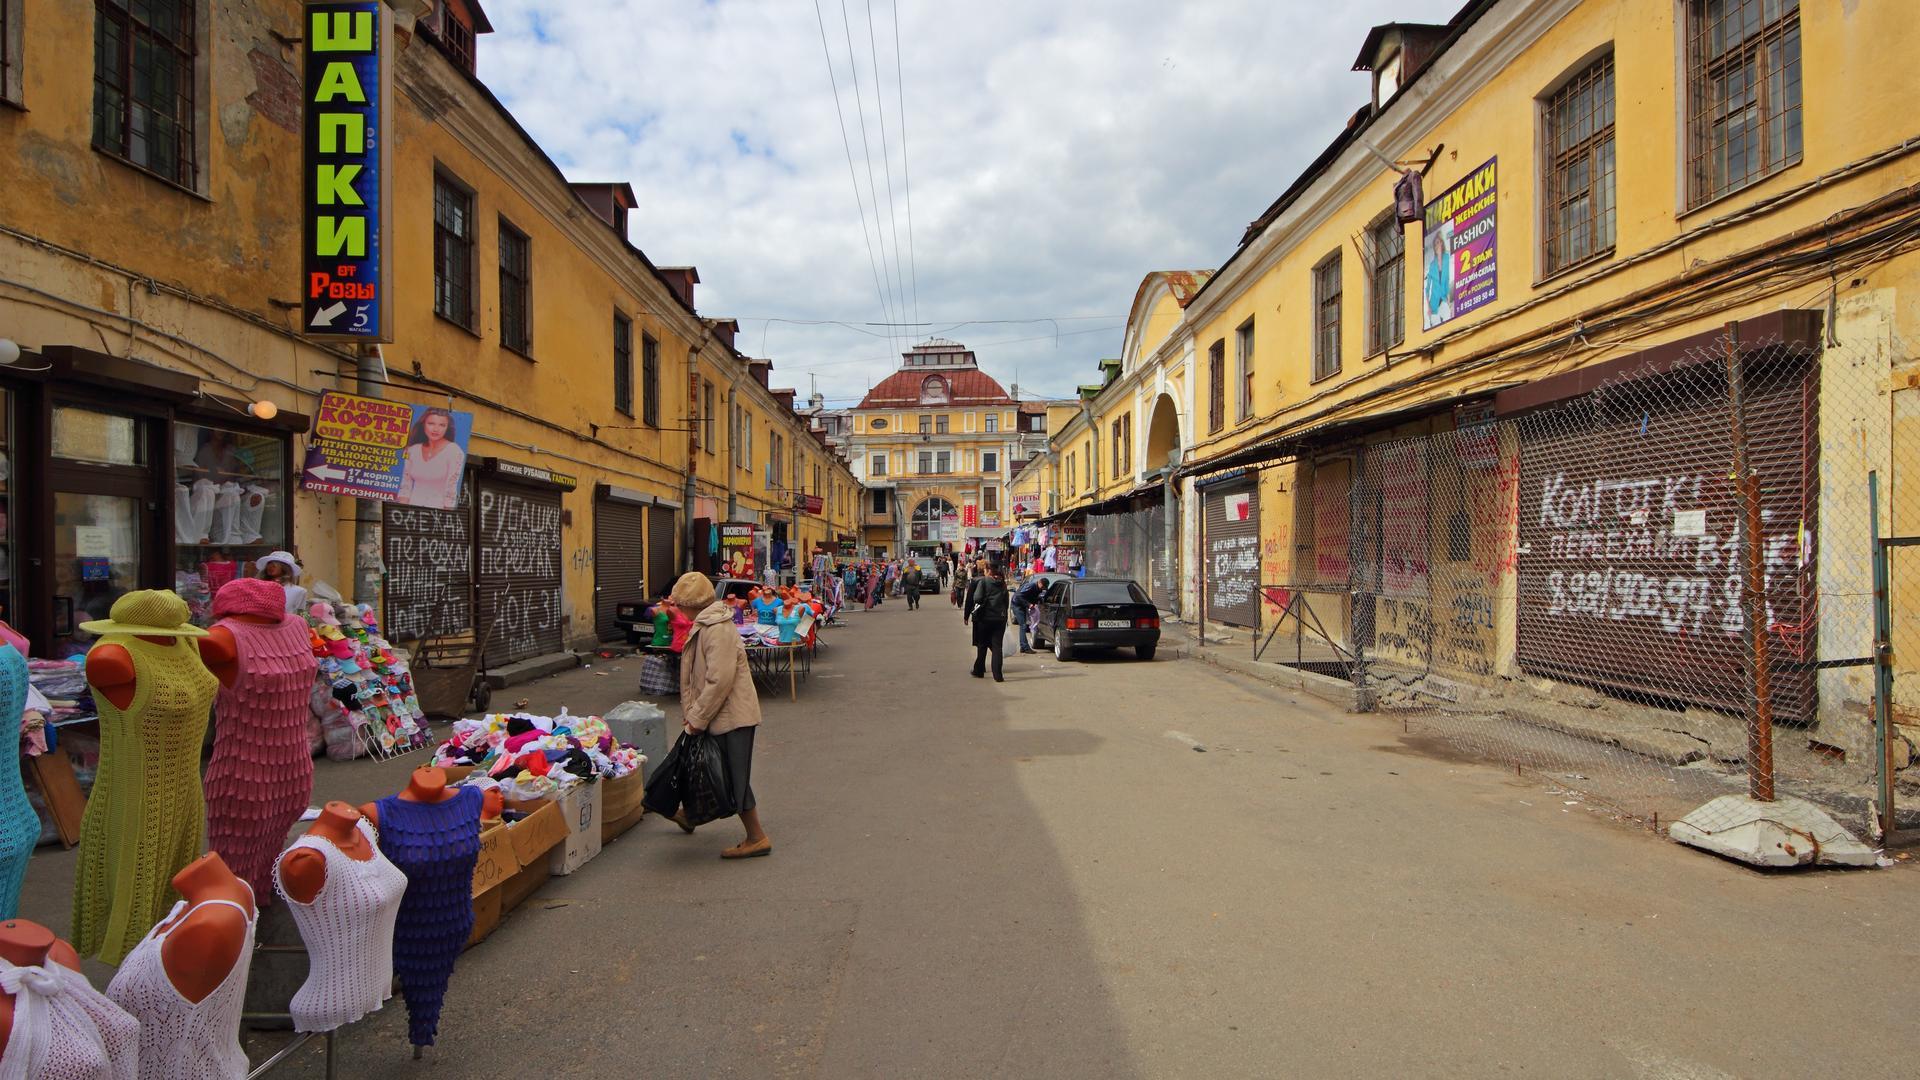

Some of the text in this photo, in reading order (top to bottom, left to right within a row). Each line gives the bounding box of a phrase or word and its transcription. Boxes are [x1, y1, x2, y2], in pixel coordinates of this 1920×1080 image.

[312, 12, 372, 257] ШАПКИ
[1425, 163, 1496, 231] ПИДЖАКИ
[1455, 192, 1496, 226] ЖЕНСКИЕ
[1453, 214, 1495, 250] FASHION
[1460, 250, 1471, 274] 2
[352, 304, 370, 328] 5
[324, 394, 411, 419] КРАСИВЫЕ
[320, 407, 410, 434] КОФТЫ
[350, 428, 406, 447] РОЗЫ
[326, 456, 391, 473] ТРИКОТАЖ
[348, 468, 400, 483] 17 корпус
[306, 482, 395, 501] ОПТ И РОЗНИЦА
[347, 475, 399, 489] 5 магазин
[723, 526, 751, 536] КОСМЕТИКА
